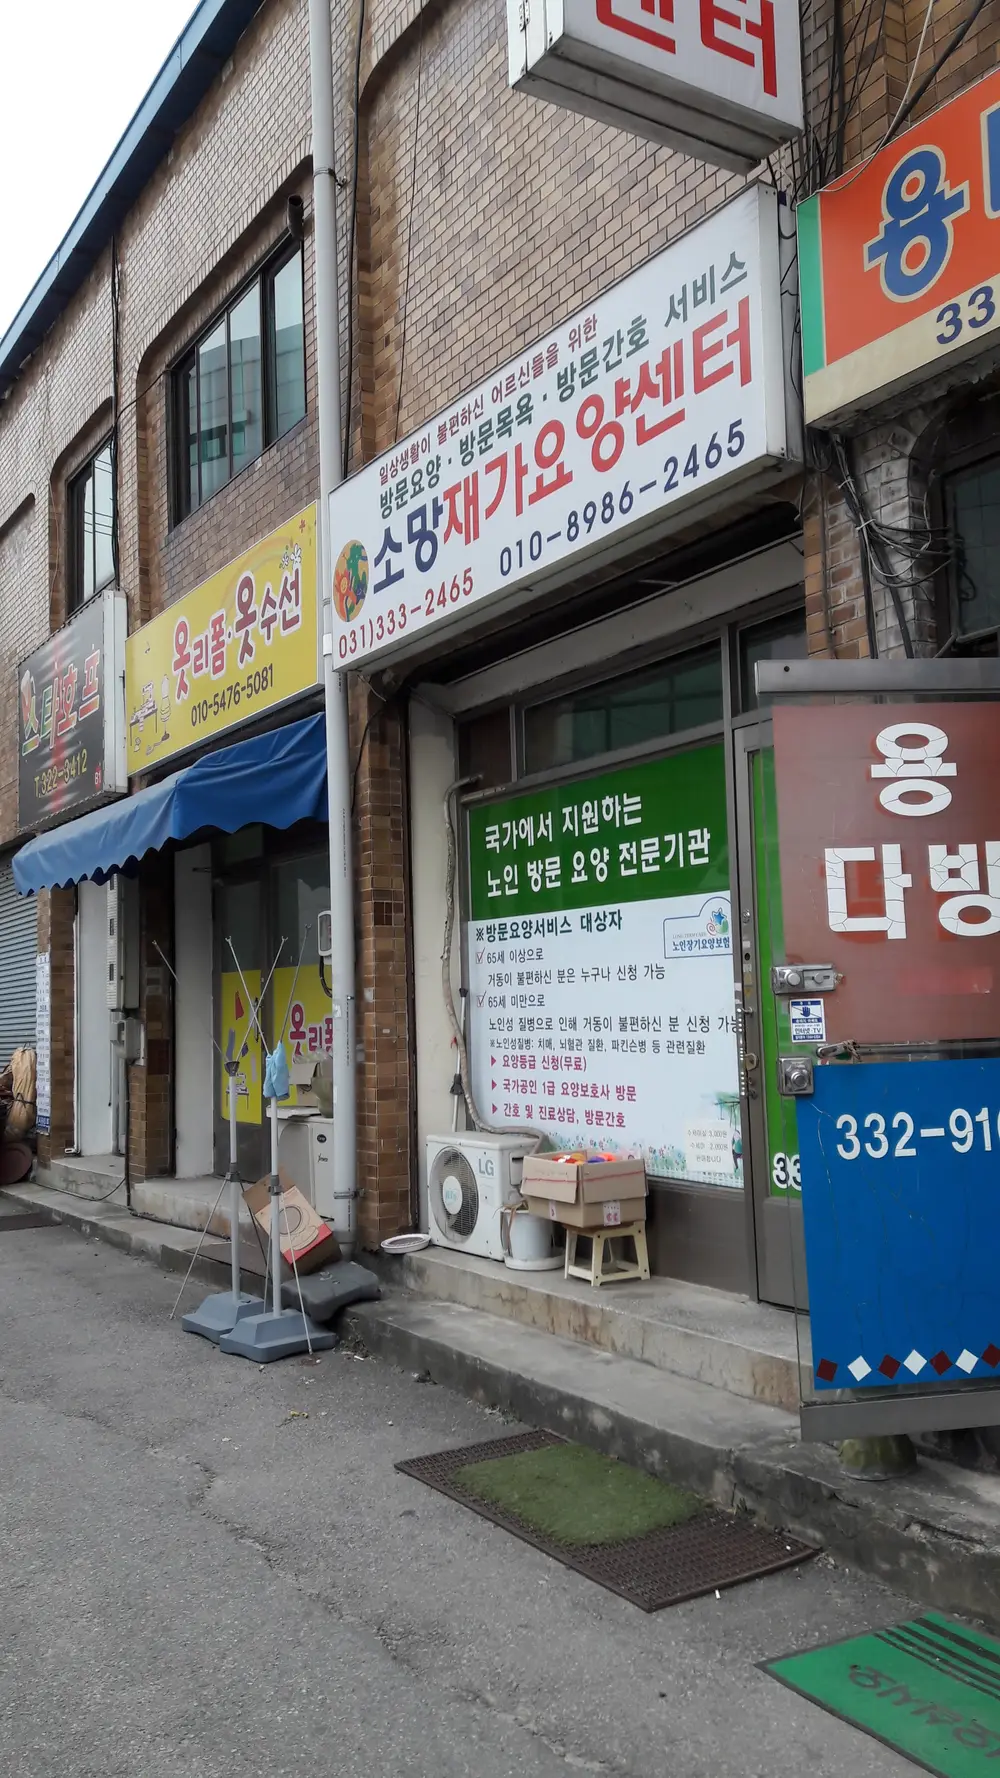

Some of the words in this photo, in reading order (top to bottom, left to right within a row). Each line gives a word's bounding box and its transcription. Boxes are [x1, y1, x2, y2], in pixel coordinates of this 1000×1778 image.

[864, 103, 1000, 303] 용
[379, 433, 431, 486] 일상생활이
[437, 394, 484, 445] 불편하신
[491, 342, 559, 405] 어르신들을
[568, 313, 598, 353] 위한
[380, 454, 441, 520] 방문요양
[460, 392, 534, 466] 방문목욕
[557, 314, 650, 402] 방문간호
[665, 251, 748, 328] 서비스
[499, 418, 745, 577] 010-8986-2465
[339, 567, 473, 659] 031)333-2465
[190, 663, 274, 727] 010-5476-5081
[870, 722, 957, 817] 용
[485, 811, 553, 854] 국가에서
[562, 792, 642, 837] 지원하는
[487, 864, 519, 897] 노인
[527, 855, 561, 893] 방문
[571, 847, 610, 883] 요양
[619, 828, 711, 877] 전문기관
[824, 841, 1000, 939] 다방
[580, 908, 622, 933] 대상자
[487, 950, 505, 964] 65세
[509, 947, 544, 964] 이상으로
[672, 937, 730, 952] 노인장기요양보험
[488, 972, 512, 987] 거동이
[517, 969, 552, 986] 불편하신
[557, 967, 575, 984] 분은
[581, 966, 611, 982] 누구나
[616, 964, 637, 981] 신청
[644, 963, 665, 980] 가능
[488, 995, 506, 1009] 65세
[511, 994, 546, 1009] 미만으로
[489, 1017, 513, 1032] 노인성
[518, 1017, 554, 1032] 질병으로
[558, 1016, 578, 1032] 인해
[583, 1016, 613, 1032] 거동이
[618, 1015, 662, 1033] 불편하신
[668, 1016, 680, 1033] 분
[686, 1015, 710, 1034] 신청
[502, 1055, 536, 1070] 요양등급
[541, 1055, 587, 1072] 신청(무료)
[560, 1038, 583, 1052] 뇌혈관
[611, 1039, 647, 1054] 파킨슨병
[652, 1040, 661, 1053] 등
[666, 1040, 706, 1055] 관련질환
[503, 1079, 537, 1095] 국가공인
[542, 1081, 556, 1096] 1급
[561, 1081, 610, 1101] 요양보호사
[616, 1085, 637, 1102] 방문
[504, 1103, 521, 1118] 간호
[525, 1104, 534, 1119] 및
[585, 1109, 626, 1128] 방문간호
[836, 1107, 1000, 1160] 332-91
[478, 1157, 495, 1176] LG
